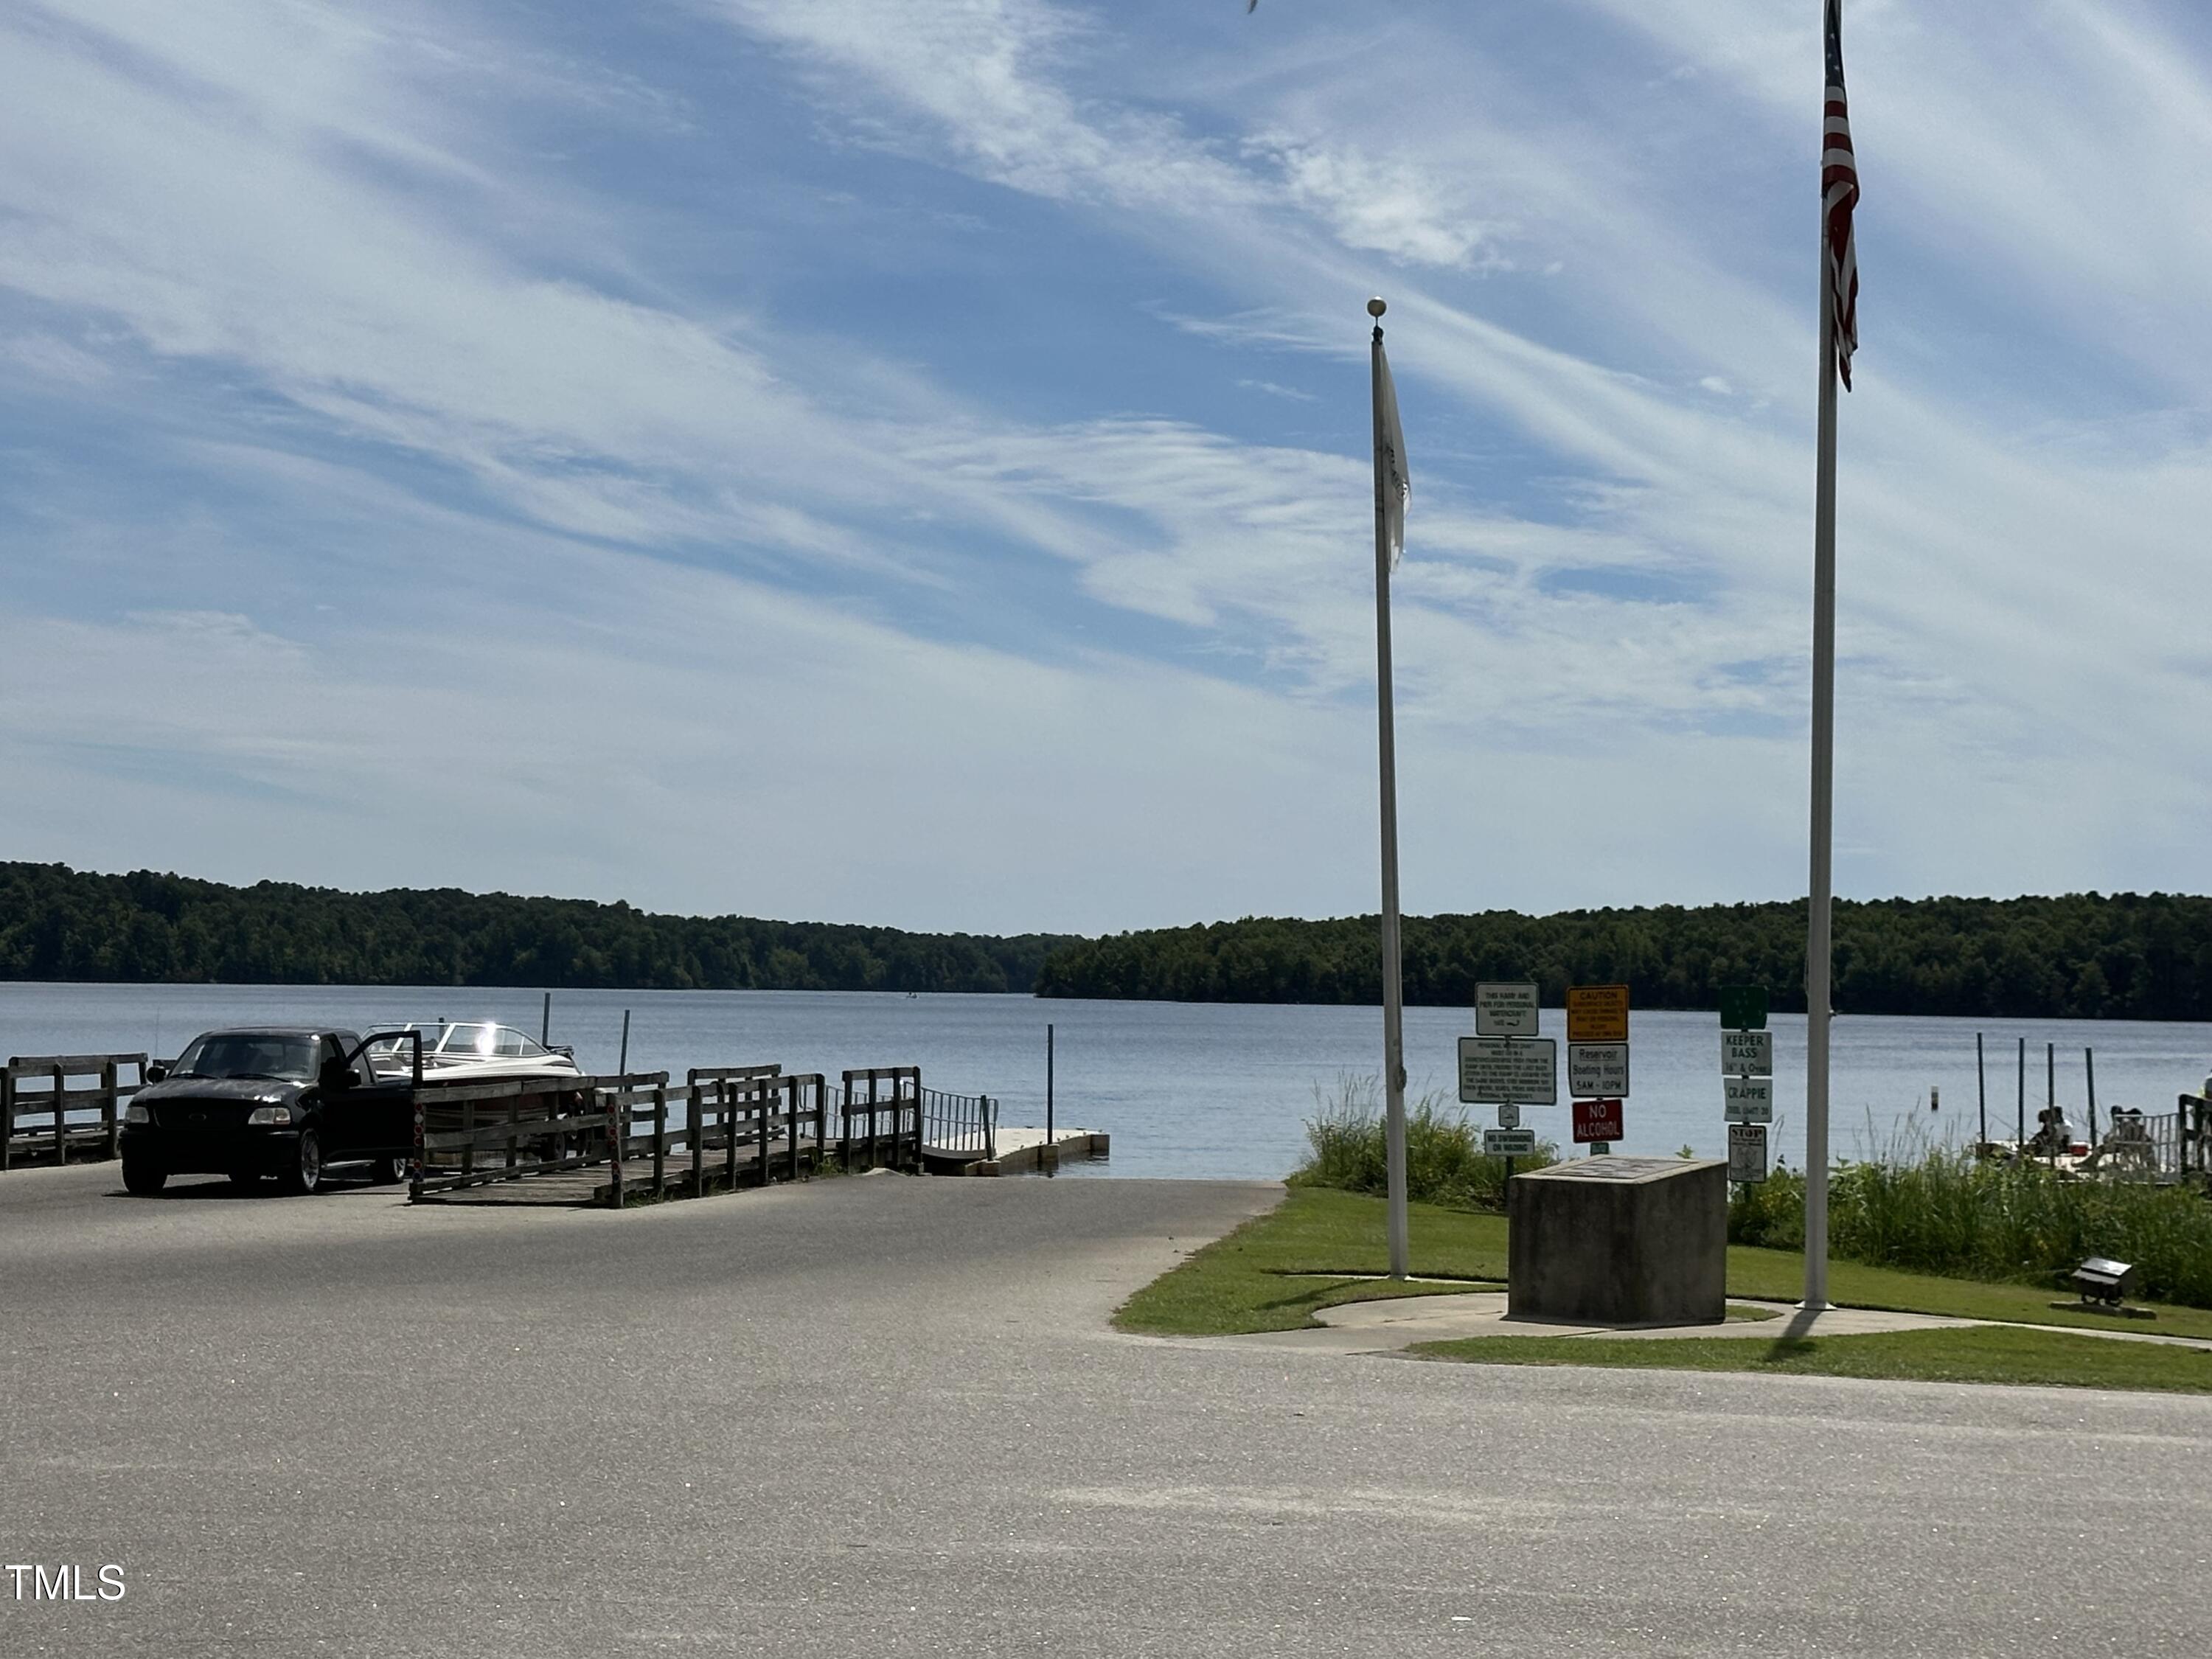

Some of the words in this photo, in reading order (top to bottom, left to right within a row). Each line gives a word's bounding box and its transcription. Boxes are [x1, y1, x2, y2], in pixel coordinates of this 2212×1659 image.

[1579, 991, 1618, 1001] CAUTION
[1726, 1034, 1764, 1046] KEEPER
[1579, 1048, 1618, 1059] Reservoir
[1731, 1047, 1758, 1058] BASS
[1573, 1064, 1601, 1078] Boating
[1603, 1064, 1624, 1075] Hours
[1741, 1063, 1745, 1072] &
[1576, 1080, 1593, 1091] 5AM
[1602, 1080, 1621, 1091] 10PM
[1728, 1086, 1767, 1099] CRAPPIE
[1589, 1104, 1607, 1119] NO
[1576, 1120, 1621, 1138] ALCOHOL
[1732, 1129, 1762, 1138] STOP
